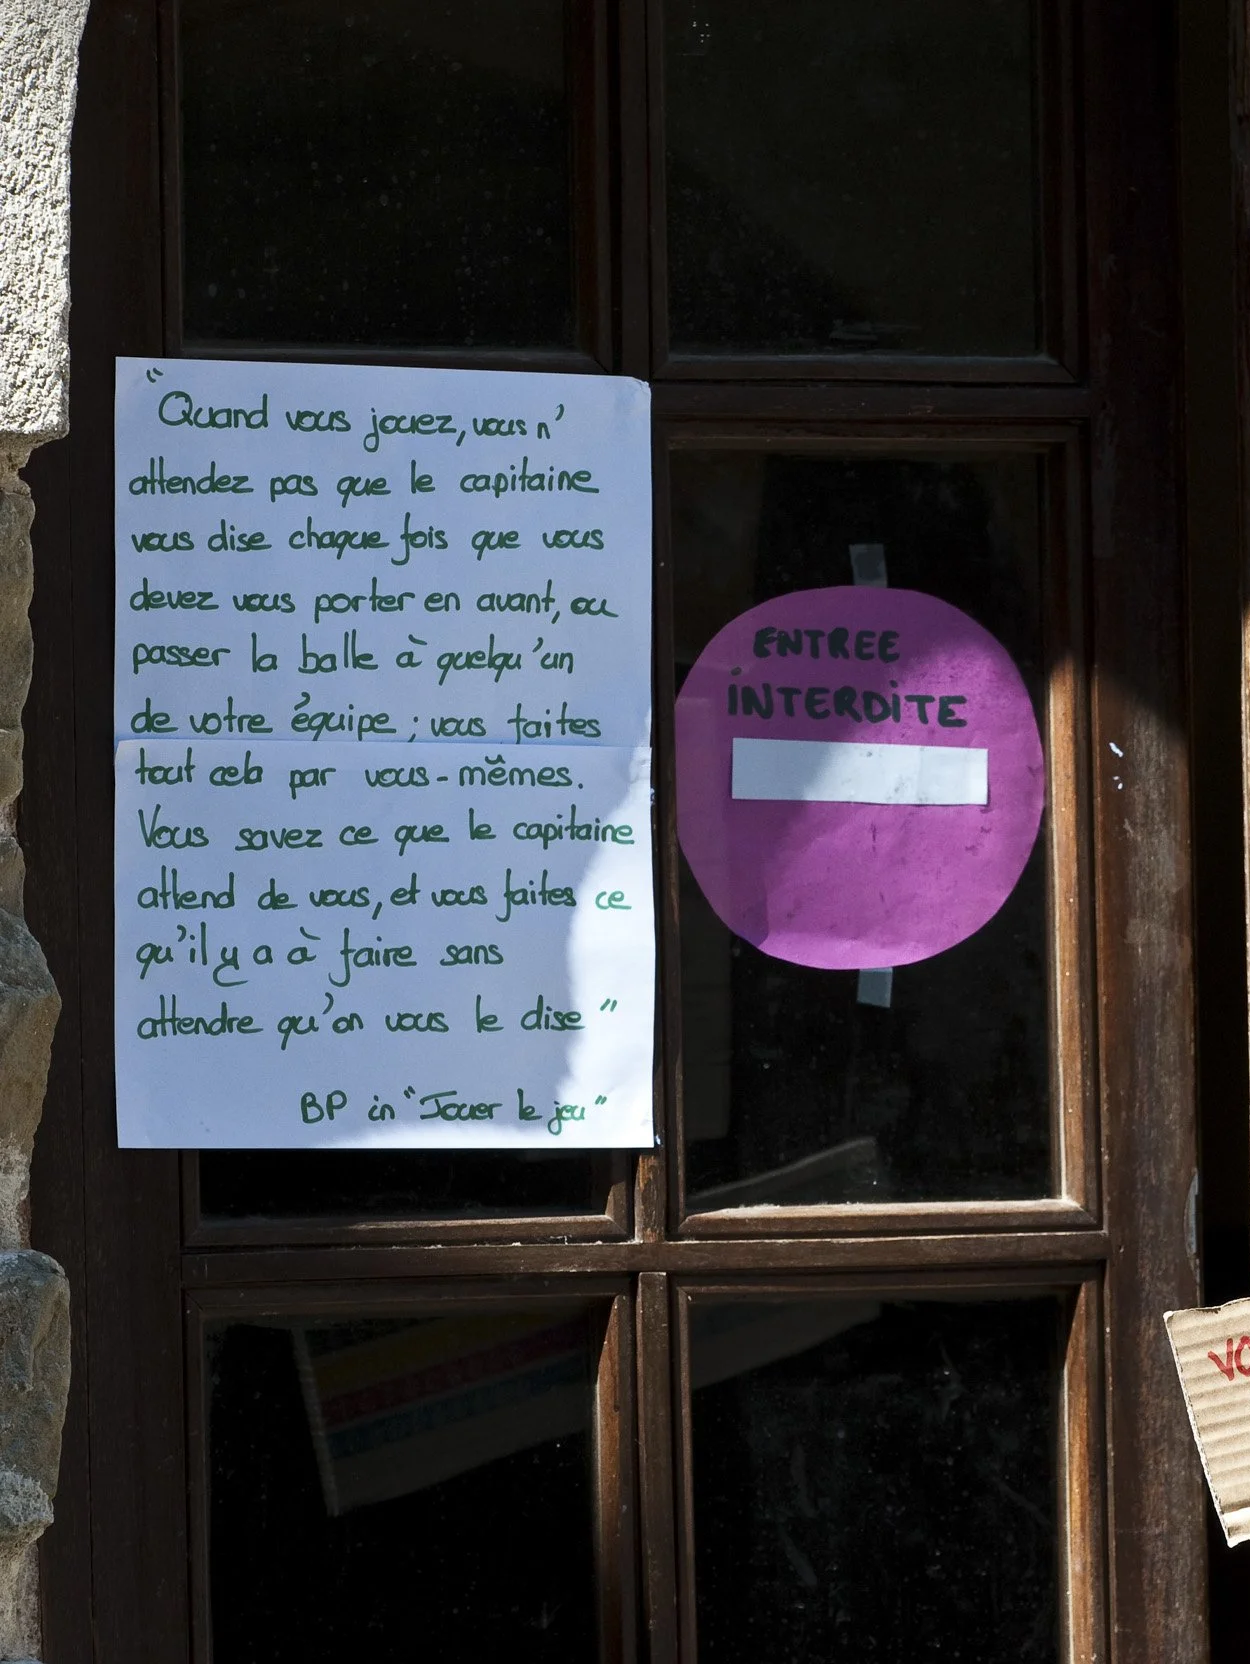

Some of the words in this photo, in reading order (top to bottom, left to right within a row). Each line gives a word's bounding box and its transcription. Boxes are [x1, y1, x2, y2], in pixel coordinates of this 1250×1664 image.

[286, 410, 351, 432] vous
[364, 407, 466, 452] jouez,
[473, 418, 527, 436] vous
[537, 404, 564, 439] n'
[129, 456, 254, 495] attendez
[270, 474, 318, 502] pas
[337, 476, 391, 508] que
[411, 460, 435, 494] le
[460, 456, 599, 498] capitaine
[132, 532, 194, 552] vous
[208, 519, 272, 552] dise
[289, 516, 389, 560] chaque
[391, 512, 448, 566] fois
[472, 530, 521, 561] que
[543, 529, 604, 550] vous
[130, 577, 219, 611] devez
[233, 593, 295, 613] vous
[314, 577, 415, 624] porter
[424, 592, 460, 612] en
[477, 579, 560, 624] avant,
[133, 643, 231, 674] passer
[252, 632, 277, 672] la
[302, 629, 378, 674] balle
[396, 634, 427, 668] à
[131, 698, 178, 733] de
[190, 696, 273, 735] votre
[431, 717, 486, 737] vous
[135, 747, 195, 785] tout
[210, 751, 263, 786] cela
[289, 768, 336, 800] par
[138, 804, 209, 849] Vous
[235, 828, 323, 851] savez
[339, 826, 378, 846] ce
[395, 825, 449, 856] que
[469, 808, 496, 840] le
[513, 804, 635, 851] capitaine
[138, 865, 235, 910] attend
[258, 878, 297, 910] de
[309, 887, 382, 920] vous,
[390, 873, 420, 906] et
[431, 886, 488, 907] vous
[496, 868, 576, 922] faites
[596, 891, 631, 909] ce
[213, 947, 247, 987] y
[253, 945, 273, 965] a
[287, 927, 320, 965] à
[329, 928, 417, 987] faire
[440, 945, 504, 966] sans
[137, 994, 263, 1039] attendre
[277, 992, 363, 1050] qu'on
[385, 1012, 449, 1033] vous
[476, 995, 504, 1033] le
[301, 1090, 347, 1124] BP
[368, 1095, 395, 1121] in
[517, 1088, 543, 1121] le
